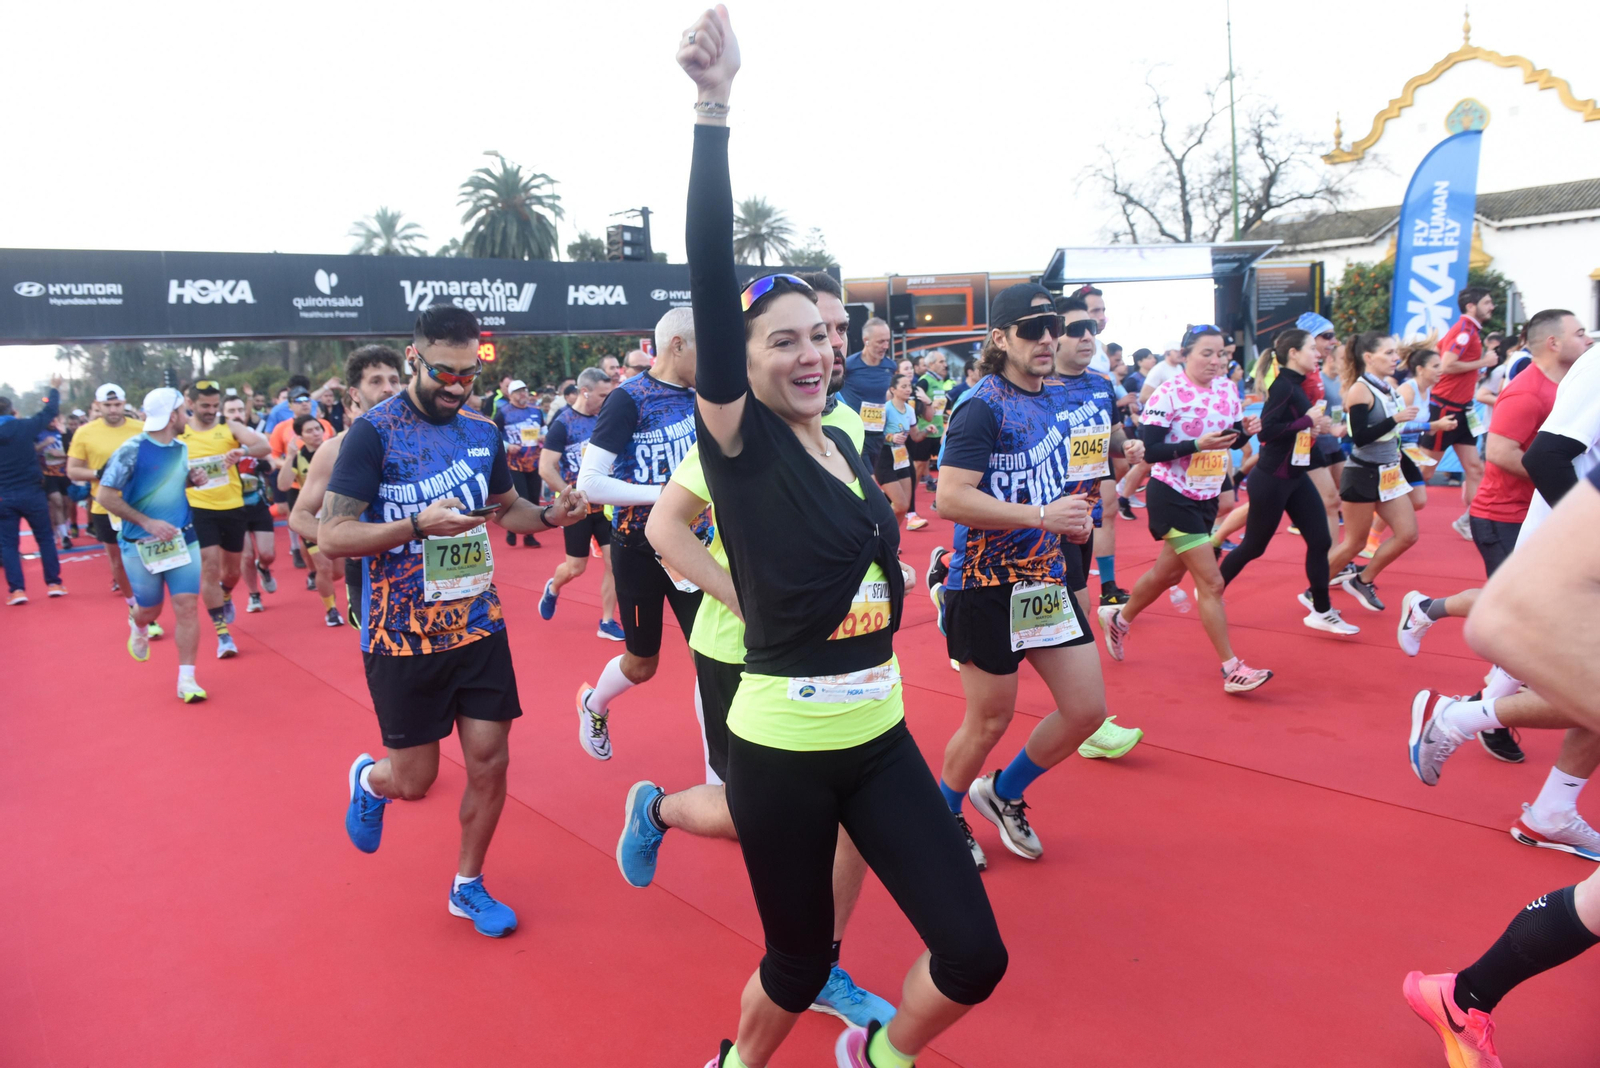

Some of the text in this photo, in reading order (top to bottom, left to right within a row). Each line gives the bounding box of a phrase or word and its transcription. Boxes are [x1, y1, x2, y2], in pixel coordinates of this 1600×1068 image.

[1427, 180, 1450, 247] HUMAN
[1412, 218, 1430, 247] FLY
[1443, 218, 1461, 247] FLY
[48, 283, 123, 296] HYUNDAI
[168, 279, 254, 305] HOKA
[431, 278, 518, 297] maratón
[567, 284, 627, 306] HOKA
[452, 291, 519, 312] sevilla
[299, 311, 334, 319] Healthcare
[483, 316, 506, 326] 2024
[1145, 409, 1166, 418] LOVE
[632, 428, 664, 444] MEDIO
[467, 447, 491, 457] HOKA
[989, 425, 1063, 471] MEDIO MARATÓN
[1073, 438, 1103, 457] 2045
[379, 459, 475, 504] MEDIO MARATÓN
[145, 541, 175, 557] 7223
[437, 541, 482, 567] 7873
[1020, 590, 1060, 618] 7034
